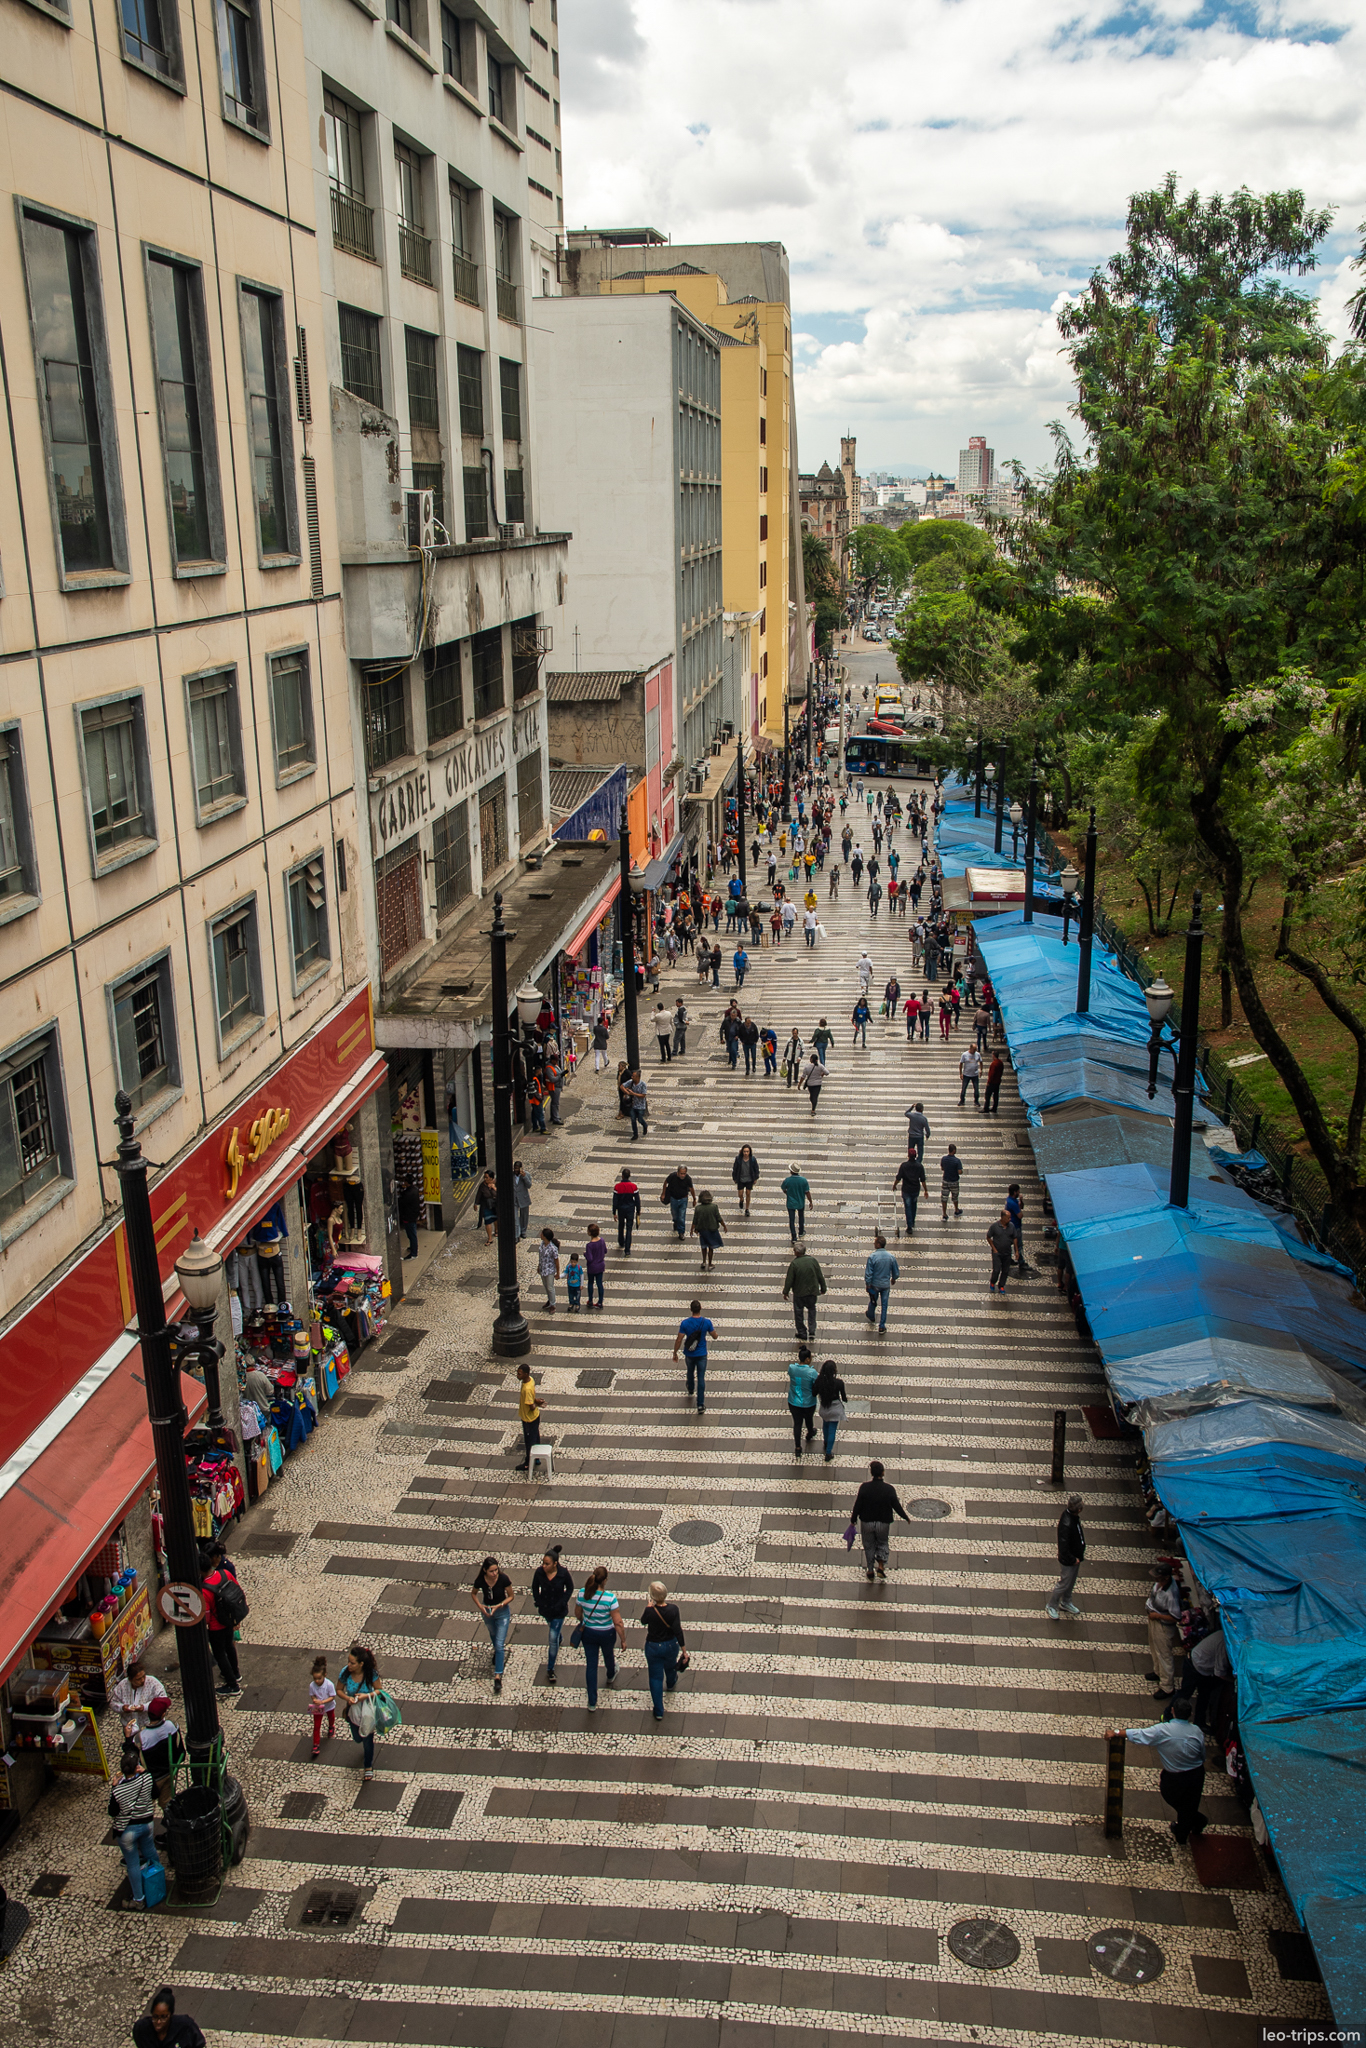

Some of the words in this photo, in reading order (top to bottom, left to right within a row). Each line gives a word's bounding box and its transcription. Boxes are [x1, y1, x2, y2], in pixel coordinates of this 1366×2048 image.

[378, 769, 436, 841] GABRIEL
[421, 1139, 438, 1151] PREÇO
[173, 1591, 192, 1618] E
